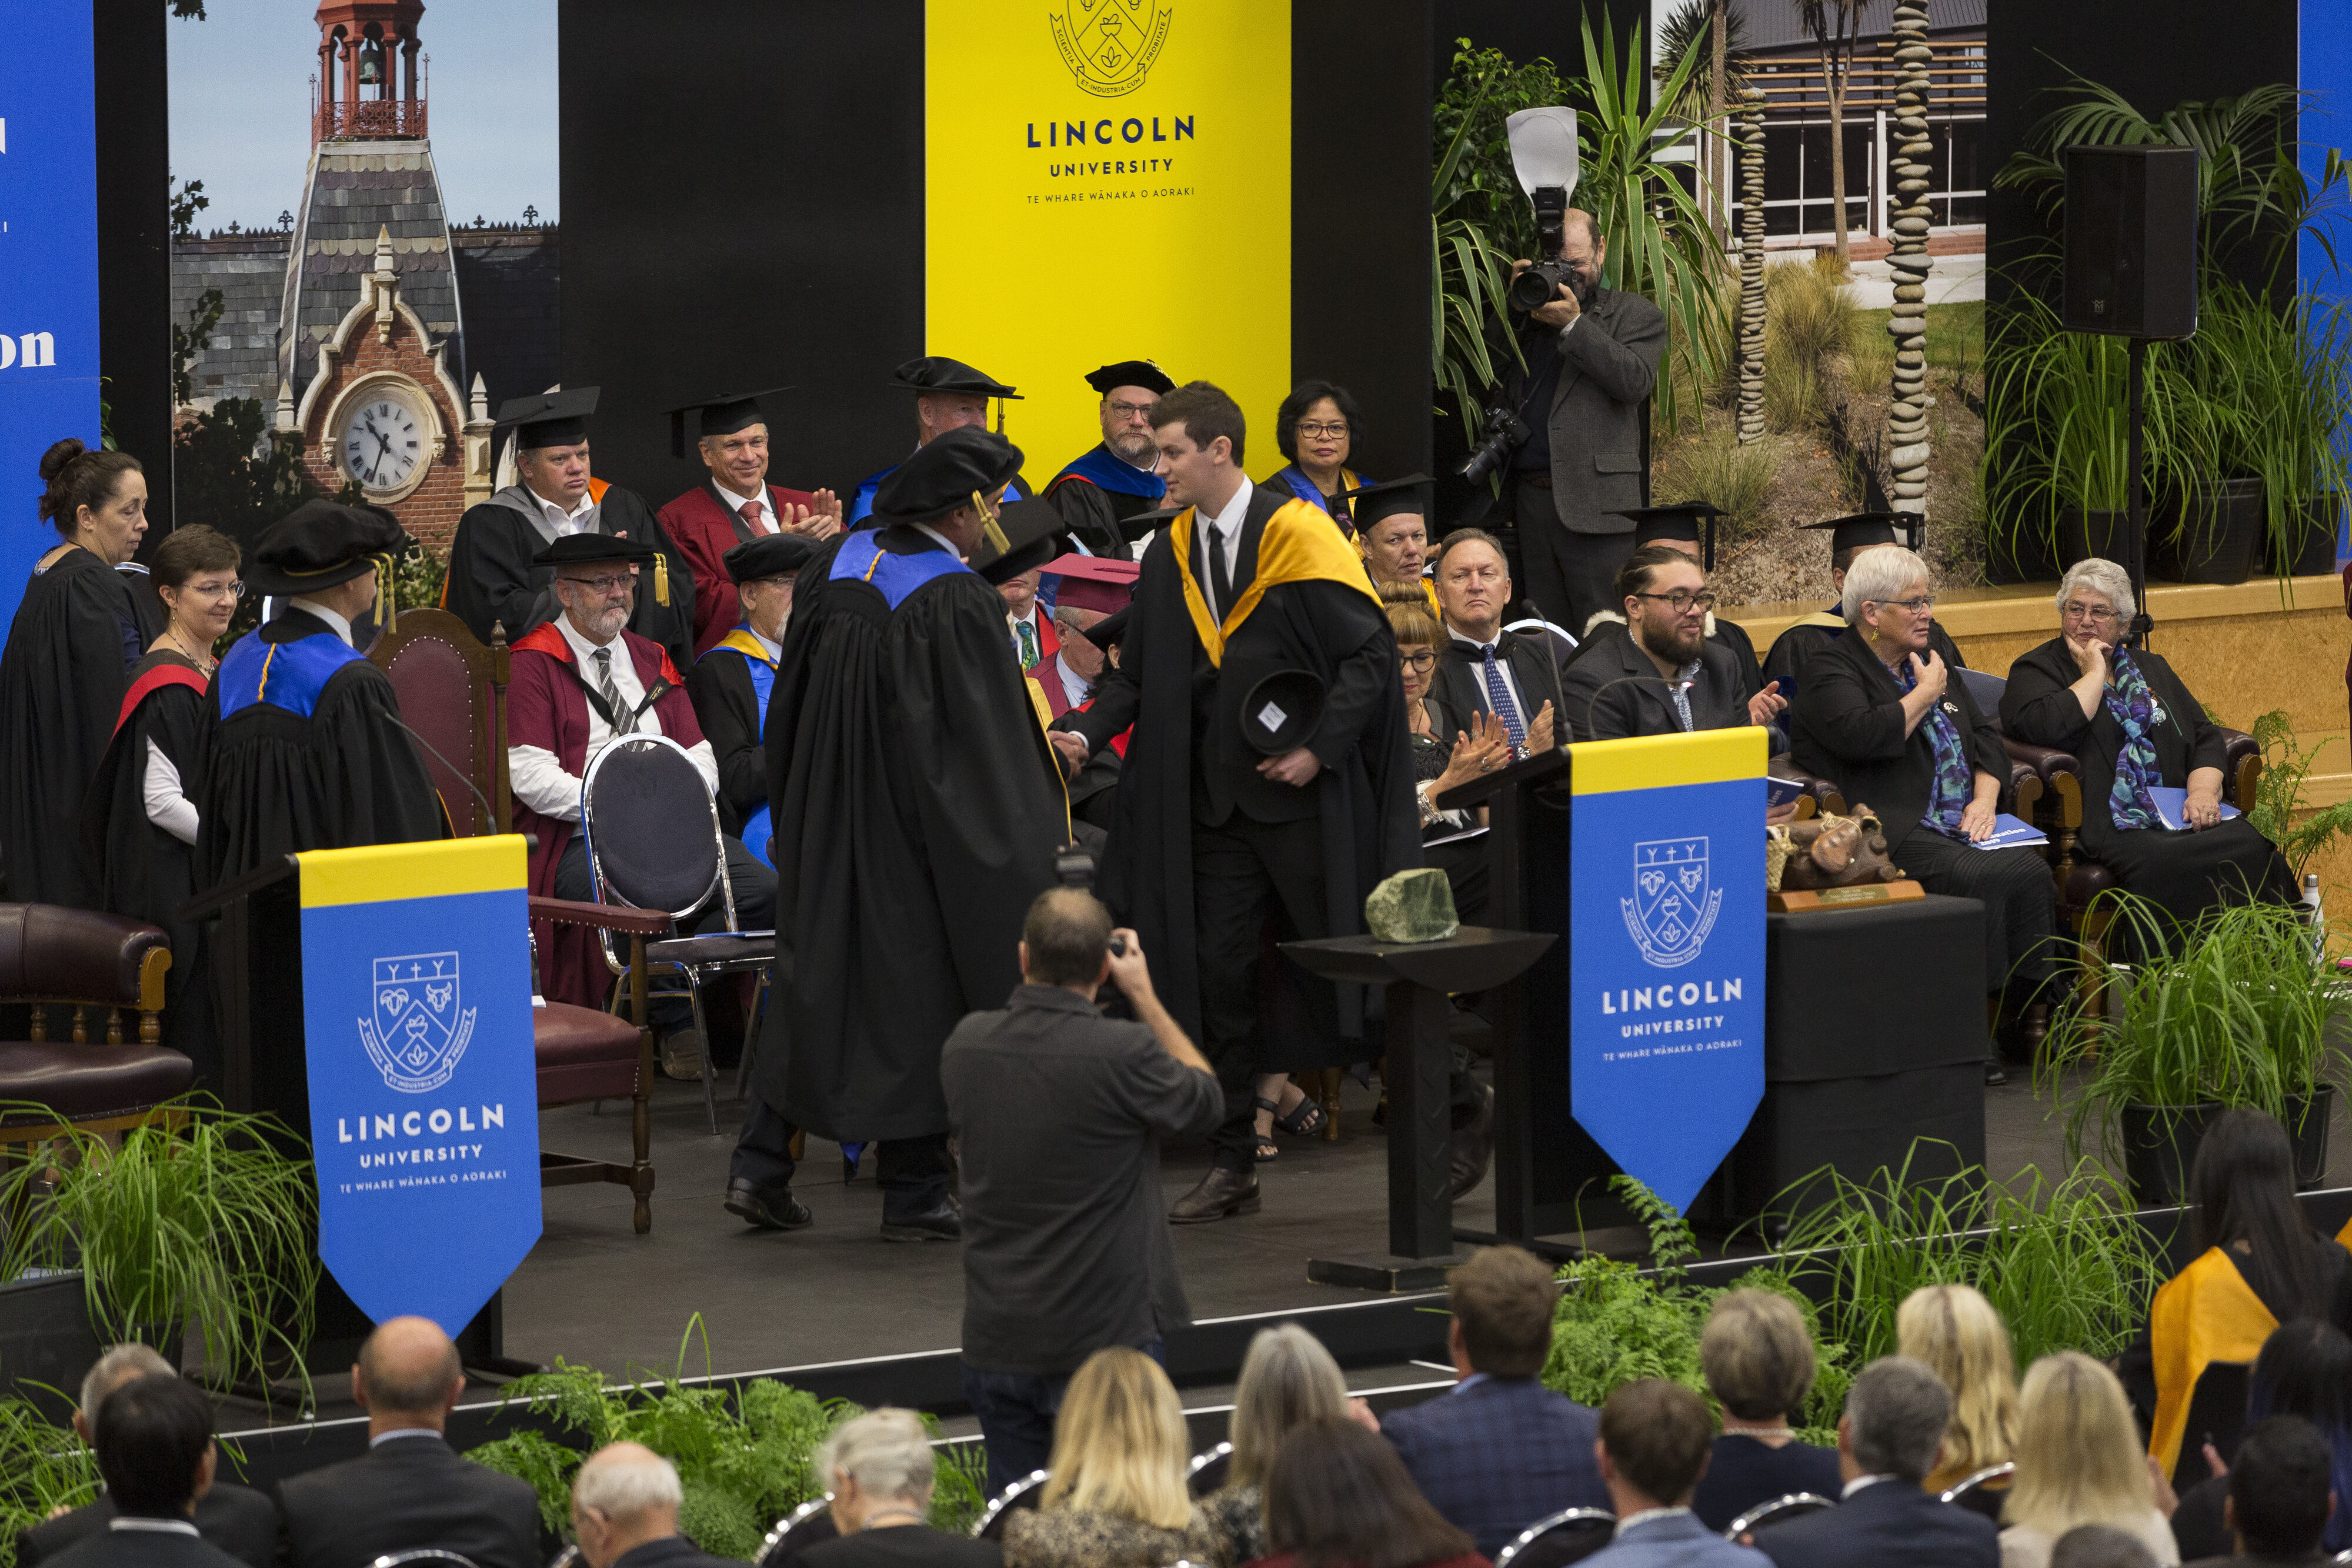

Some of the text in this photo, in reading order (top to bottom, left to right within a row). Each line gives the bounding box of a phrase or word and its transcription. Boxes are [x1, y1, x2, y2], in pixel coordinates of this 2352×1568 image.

[1056, 29, 1075, 64] SCIENTIA
[1146, 21, 1166, 61] PROBITATE
[1027, 115, 1194, 148] LINCOLN
[1050, 158, 1173, 177] UNIVERSITY
[1045, 193, 1084, 202] WHARE
[1089, 190, 1136, 201] WĀNAKA
[1153, 187, 1195, 197] AORAKI
[1603, 978, 1742, 1015] LINCOLN
[1622, 1015, 1724, 1038] UNIVERSITY
[1603, 1052, 1614, 1061] TE
[1619, 1049, 1651, 1059] WHARE
[1696, 1043, 1703, 1051] O
[1707, 1039, 1742, 1050] AORAKI
[338, 1103, 504, 1143] LINCOLN
[360, 1144, 483, 1168] UNIVERSITY
[340, 1183, 351, 1194] TE
[356, 1179, 394, 1191] WHARE
[450, 1173, 458, 1183] O
[462, 1170, 506, 1182] AORAKI
